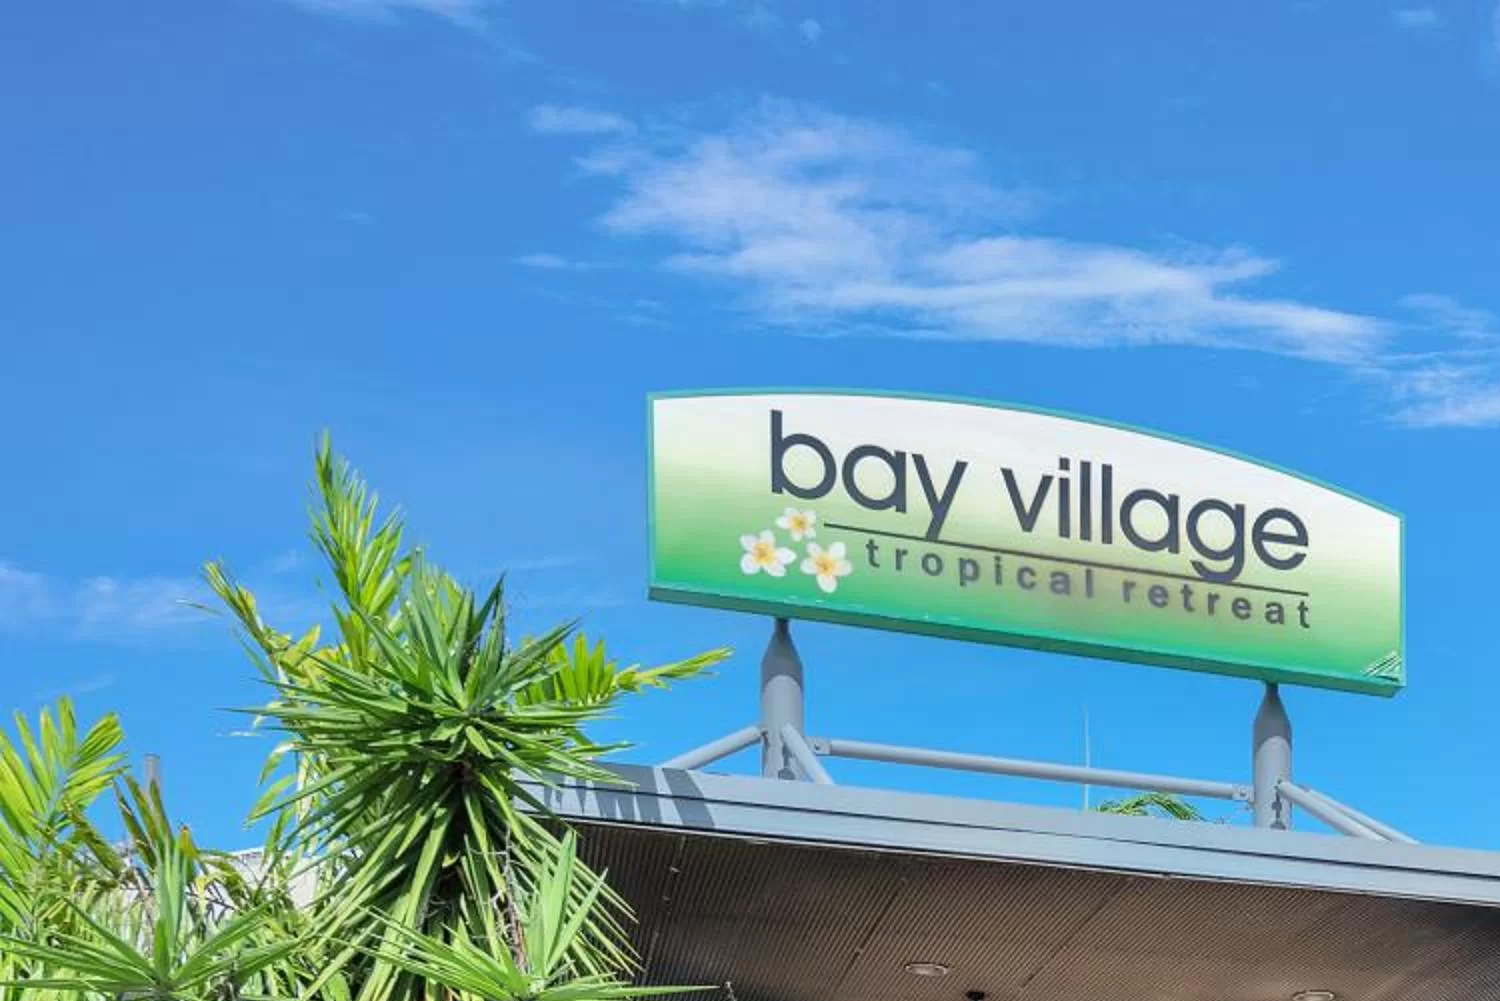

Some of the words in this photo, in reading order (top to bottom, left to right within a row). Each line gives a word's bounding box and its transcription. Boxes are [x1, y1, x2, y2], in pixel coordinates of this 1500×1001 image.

[770, 409, 968, 541] bay
[1001, 456, 1310, 583] village
[865, 536, 1096, 599] tropical
[1122, 578, 1312, 629] retreat
